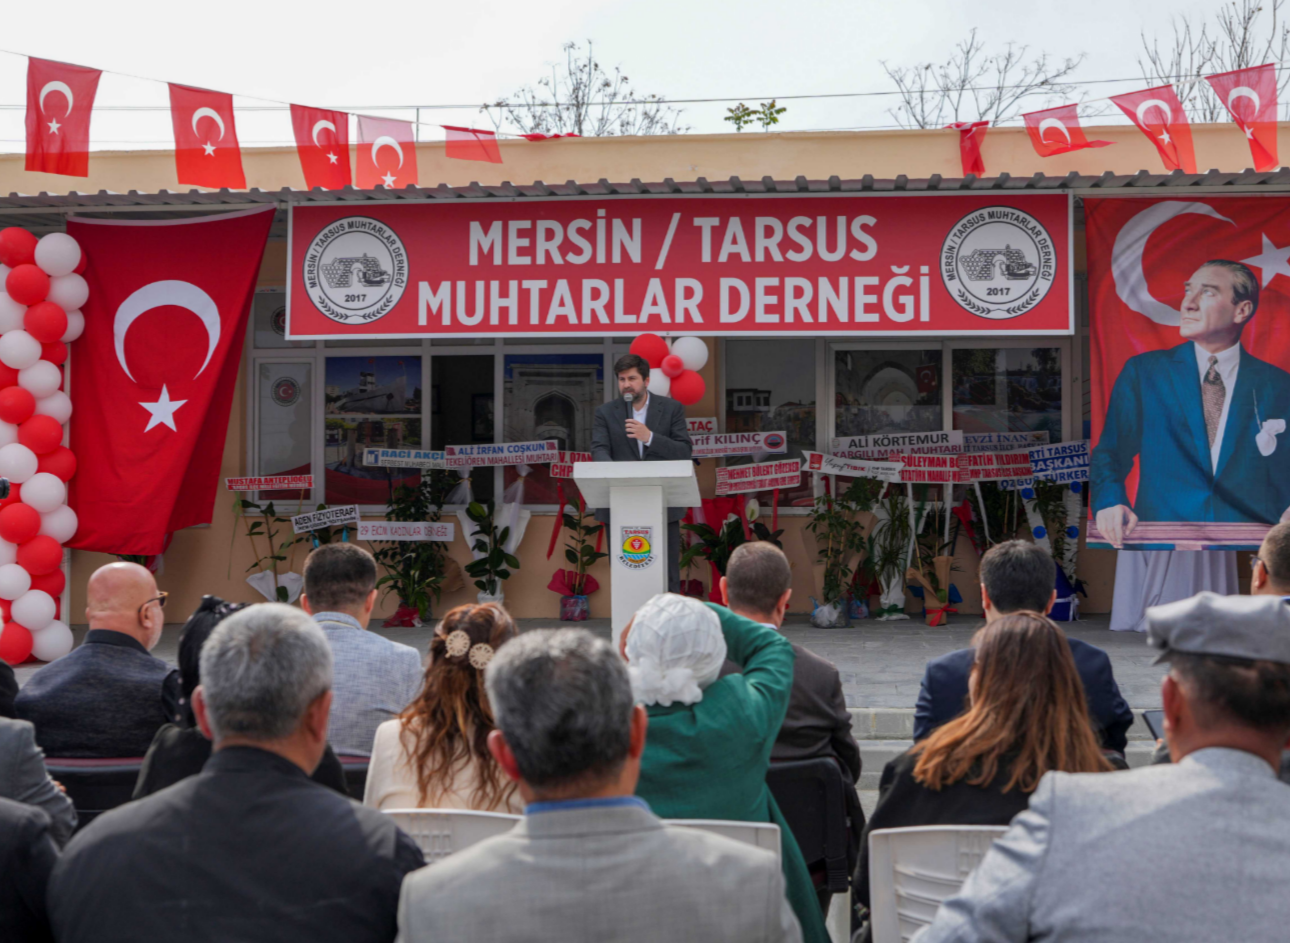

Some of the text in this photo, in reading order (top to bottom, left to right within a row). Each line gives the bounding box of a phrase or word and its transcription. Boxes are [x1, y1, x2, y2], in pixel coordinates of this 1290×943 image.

[469, 209, 878, 270] MERSİN / TARSUS
[944, 244, 956, 281] MERSİN
[953, 213, 986, 239] TARSUS
[987, 210, 1043, 239] MUHTARLAR
[1037, 238, 1052, 282] DERNEĞİ
[307, 254, 318, 289] MERSİN
[315, 223, 346, 248] TARSUS
[347, 220, 397, 248] MUHTARLAR
[392, 246, 405, 289] DERNEĞİ
[344, 294, 367, 302] 2017
[418, 265, 930, 326] MUHTARLAR DERNEĞİ
[986, 288, 1011, 296] 2017
[687, 421, 713, 432] TAÇ
[714, 433, 761, 445] KILINÇ
[848, 433, 949, 449] ALİ KÖRTEMUR
[965, 433, 1028, 444] EVZİ İNAN
[381, 450, 411, 458] RACİ
[458, 443, 545, 455] ALİ İRFAN COŞKUN
[832, 449, 874, 459] KARGILI
[910, 444, 962, 454] MUHTARI
[1029, 443, 1086, 459] RTİ TARSUS
[487, 454, 525, 465] MAHALLESİ
[526, 452, 557, 463] MUHTARI
[901, 454, 947, 468] SÜLEYMAN
[968, 453, 1031, 466] FATİH YILDIRIM
[552, 464, 573, 477] CHP
[1043, 469, 1088, 482] TÜRKER
[227, 477, 262, 485] MUSTAFA
[294, 515, 312, 526] ADEN
[312, 505, 357, 522] FİZYOTERAPİ
[360, 525, 369, 536] 29
[371, 524, 388, 536] EKİM
